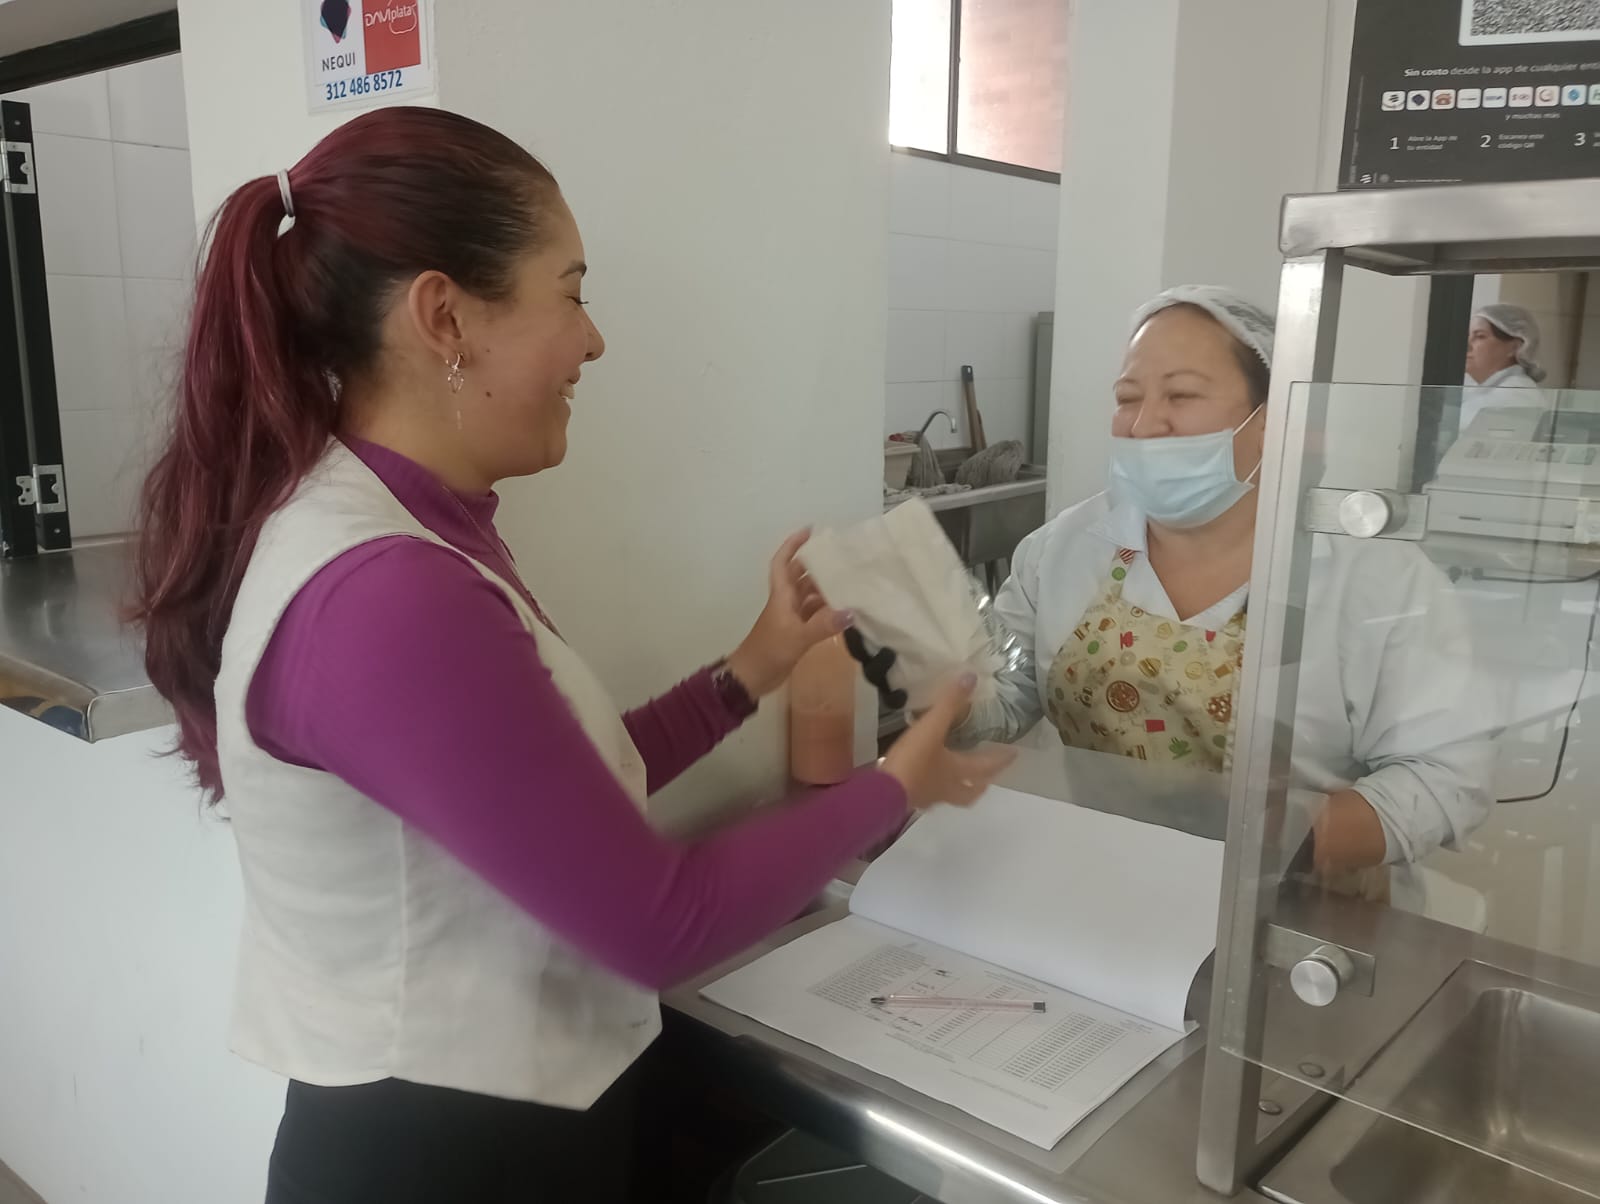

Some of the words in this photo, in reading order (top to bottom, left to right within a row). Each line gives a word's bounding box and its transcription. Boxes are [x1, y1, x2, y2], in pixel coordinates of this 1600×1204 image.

[321, 52, 356, 71] NEQUI
[1404, 68, 1420, 77] Sin
[1421, 68, 1449, 76] costo
[1450, 66, 1480, 75] desde
[1493, 66, 1513, 75] app
[1514, 65, 1529, 73] de
[326, 80, 347, 100] 312
[350, 75, 371, 95] 486
[373, 70, 403, 91] 8572
[1389, 137, 1400, 150] 1
[1480, 134, 1491, 148] 2
[1574, 132, 1586, 146] 3
